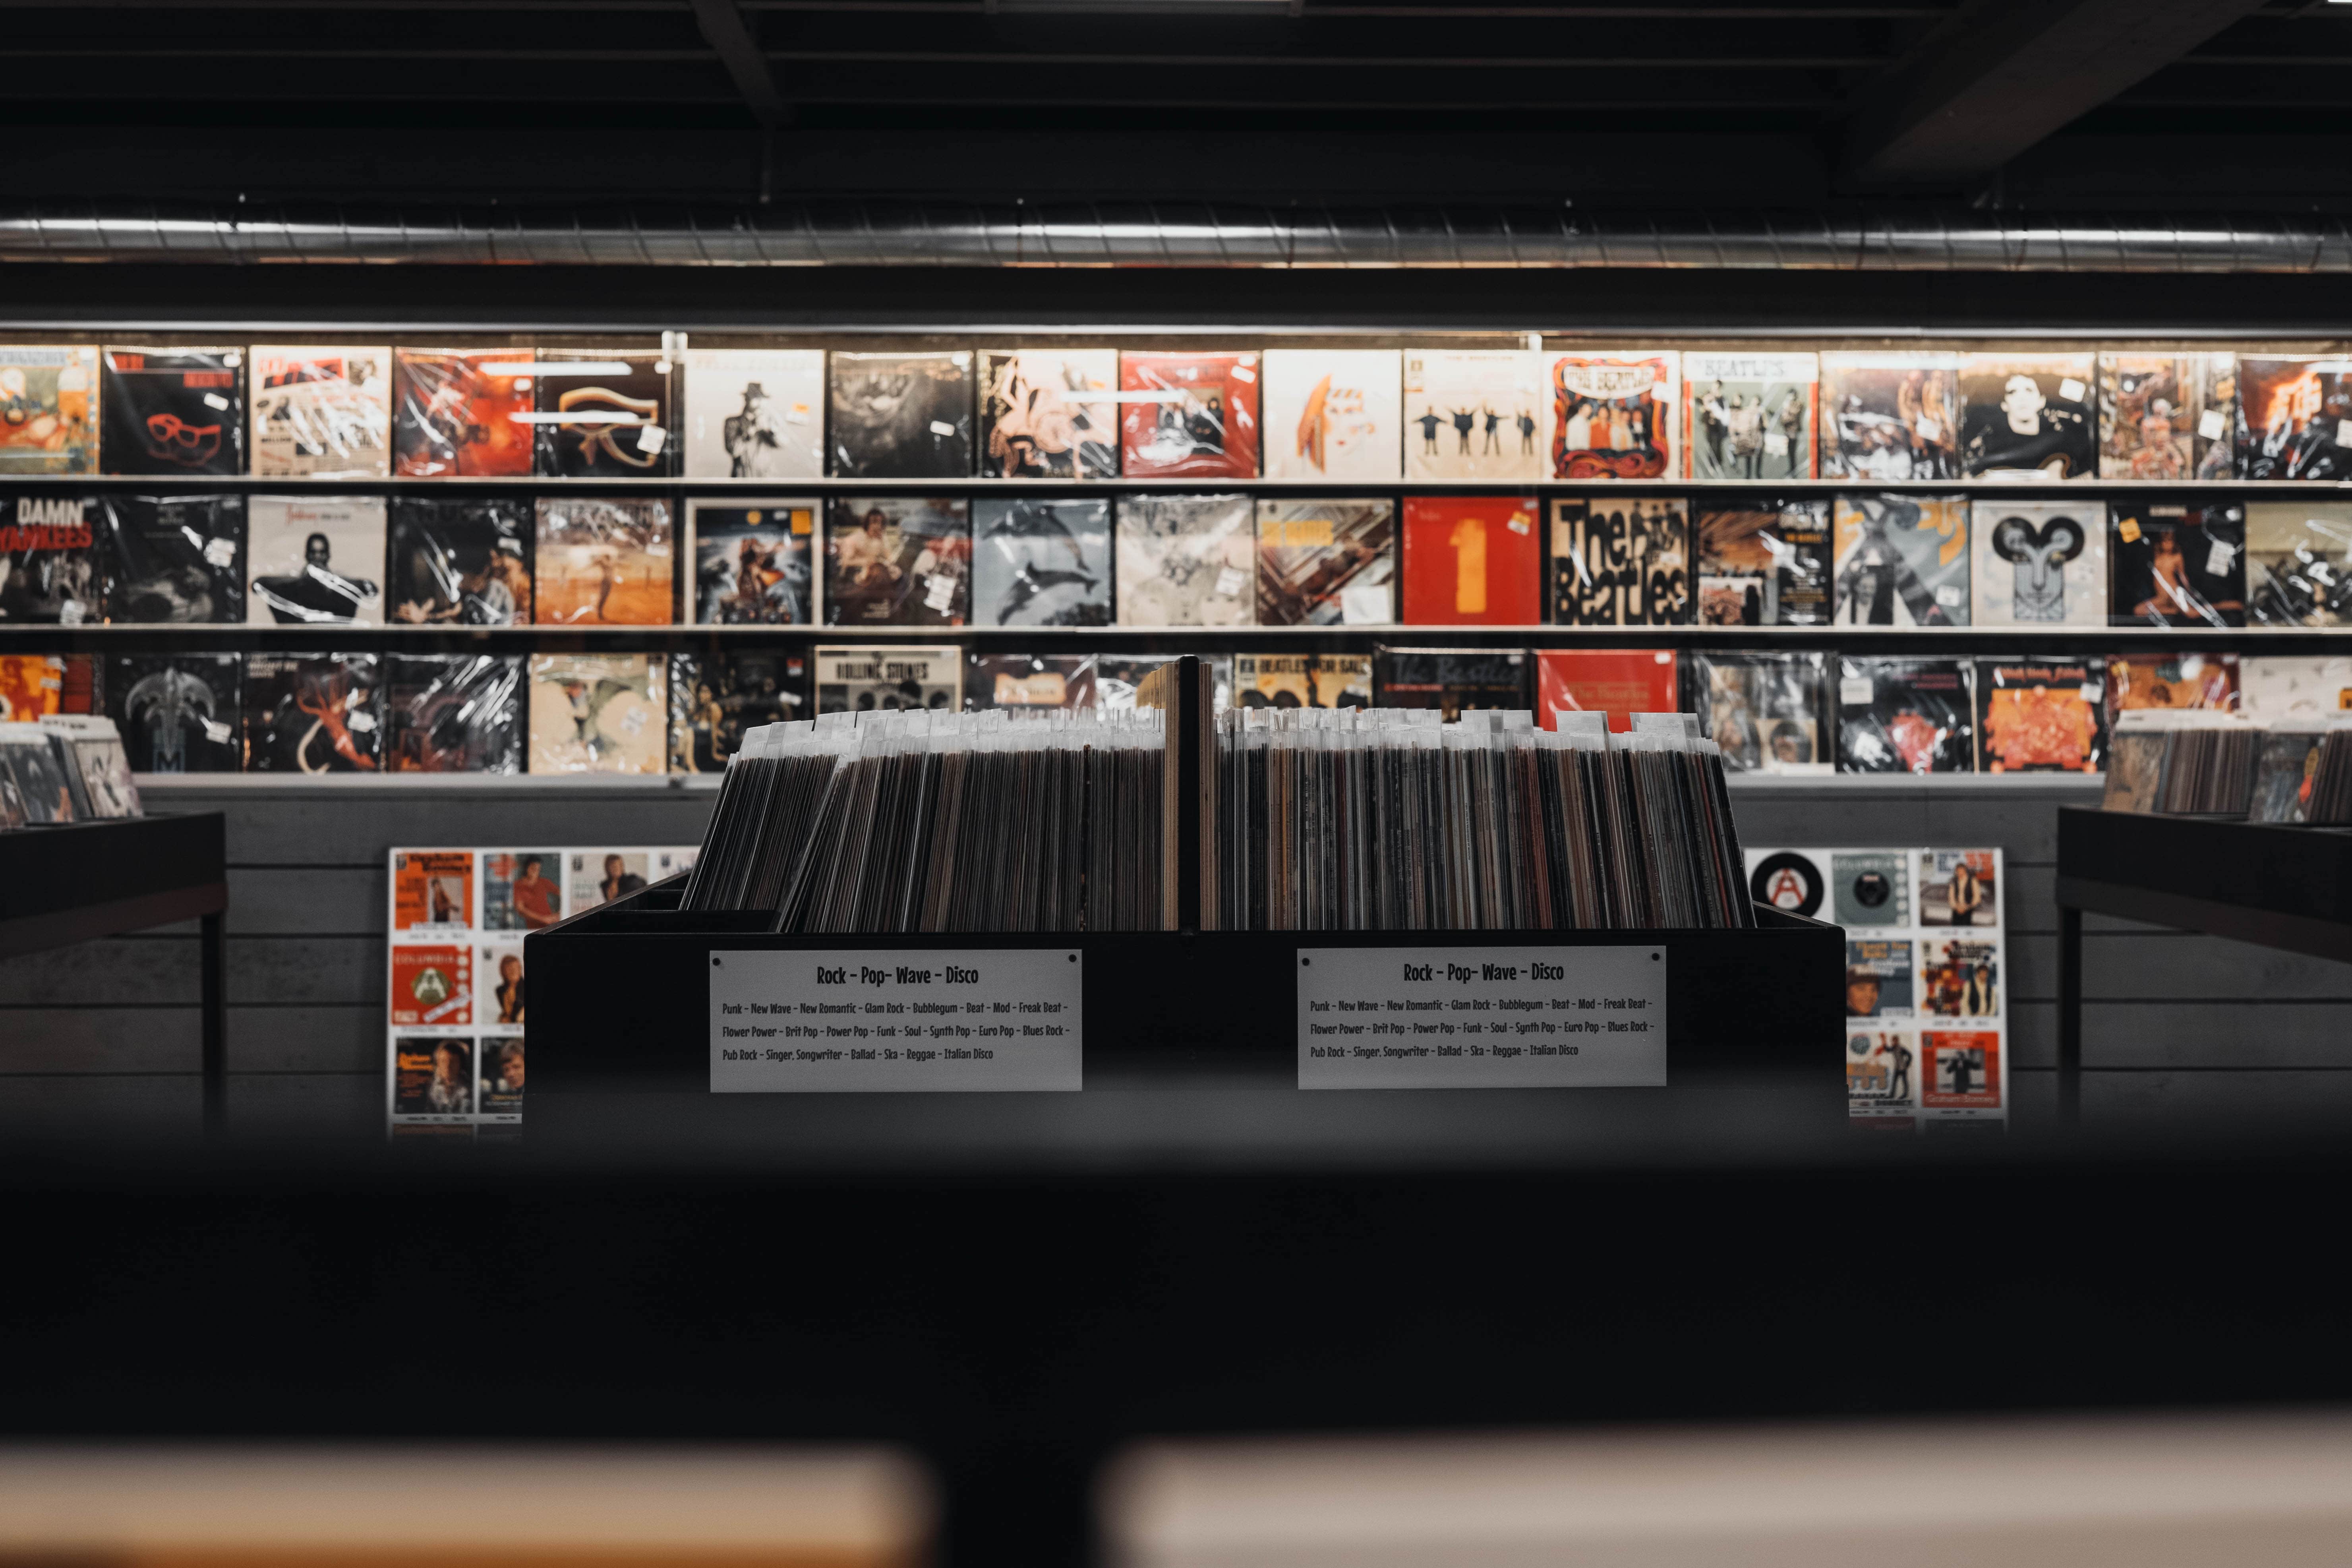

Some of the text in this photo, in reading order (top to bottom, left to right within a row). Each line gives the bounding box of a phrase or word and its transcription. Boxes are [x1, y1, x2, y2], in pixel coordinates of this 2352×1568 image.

[17, 496, 84, 528] DAMN
[1560, 497, 1627, 571] The
[1449, 518, 1487, 614] 1
[1555, 557, 1687, 625] Beatles
[817, 965, 847, 985] Rock
[896, 966, 931, 984] Wave
[946, 965, 979, 984] Disco
[1404, 963, 1433, 982] Rock
[1482, 963, 1517, 981] Wave
[1532, 962, 1564, 981] Disco
[722, 1003, 743, 1014] Punk
[750, 1003, 768, 1014] New
[770, 1003, 791, 1014] Wave
[800, 1002, 818, 1014] New
[819, 1002, 857, 1014] Romantic
[865, 1002, 885, 1014] Glam
[886, 1002, 905, 1014] Rock
[913, 1002, 958, 1016] Bubblegum
[966, 1002, 985, 1013] Beat
[993, 1002, 1010, 1013] Mod
[1019, 1002, 1042, 1013] Freak
[1043, 1002, 1062, 1013] Beat
[1310, 1000, 1330, 1012] Punk
[1338, 1000, 1356, 1011] New
[1357, 1000, 1379, 1011] Wave
[1387, 1000, 1404, 1011] New
[1406, 999, 1443, 1011] Romantic
[1451, 999, 1471, 1011] Glam
[1472, 999, 1491, 1010] Rock
[1499, 999, 1543, 1013] Bubblegum
[1551, 998, 1570, 1009] Beat
[1578, 998, 1596, 1010] Mod
[1604, 998, 1626, 1009] Freak
[1628, 998, 1646, 1009] Beat
[722, 1026, 750, 1038] Flower
[751, 1026, 777, 1037] Power
[785, 1026, 802, 1037] Brit
[803, 1025, 818, 1039] Pop
[826, 1025, 852, 1037] Power
[853, 1025, 868, 1039] Pop
[877, 1025, 896, 1037] Funk
[904, 1025, 921, 1037] Soul
[929, 1025, 954, 1039] Synth
[956, 1025, 971, 1038] Pop
[979, 1025, 998, 1036] Euro
[999, 1025, 1015, 1038] Pop
[1023, 1025, 1044, 1036] Blues
[1045, 1024, 1063, 1036] Rock
[1310, 1023, 1338, 1035] Flower
[1339, 1023, 1365, 1034] Power
[1372, 1023, 1389, 1034] Brit
[1390, 1023, 1405, 1036] Pop
[1413, 1022, 1439, 1034] Power
[1440, 1022, 1455, 1036] Pop
[1463, 1022, 1482, 1033] Funk
[1490, 1021, 1507, 1033] Soul
[1515, 1021, 1540, 1035] Synth
[1541, 1021, 1556, 1035] Pop
[1564, 1021, 1583, 1032] Euro
[1584, 1021, 1600, 1034] Pop
[1607, 1021, 1629, 1032] Blues
[1630, 1021, 1648, 1032] Rock
[722, 1049, 738, 1061] Pub
[739, 1049, 758, 1061] Rock
[796, 1048, 843, 1063] Songwriter
[851, 1048, 876, 1060] Ballad
[884, 1048, 898, 1060] Ska
[907, 1048, 936, 1062] Reggae
[944, 1048, 972, 1060] Italian
[973, 1048, 994, 1060] Disco
[1310, 1046, 1325, 1058] Pub
[1327, 1046, 1345, 1058] Rock
[1383, 1045, 1429, 1059] Songwriter
[1437, 1045, 1462, 1057] Ballad
[1470, 1045, 1484, 1056] Ska
[1493, 1044, 1522, 1058] Reggae
[1530, 1044, 1557, 1056] Italian
[1559, 1044, 1579, 1056] Disco
